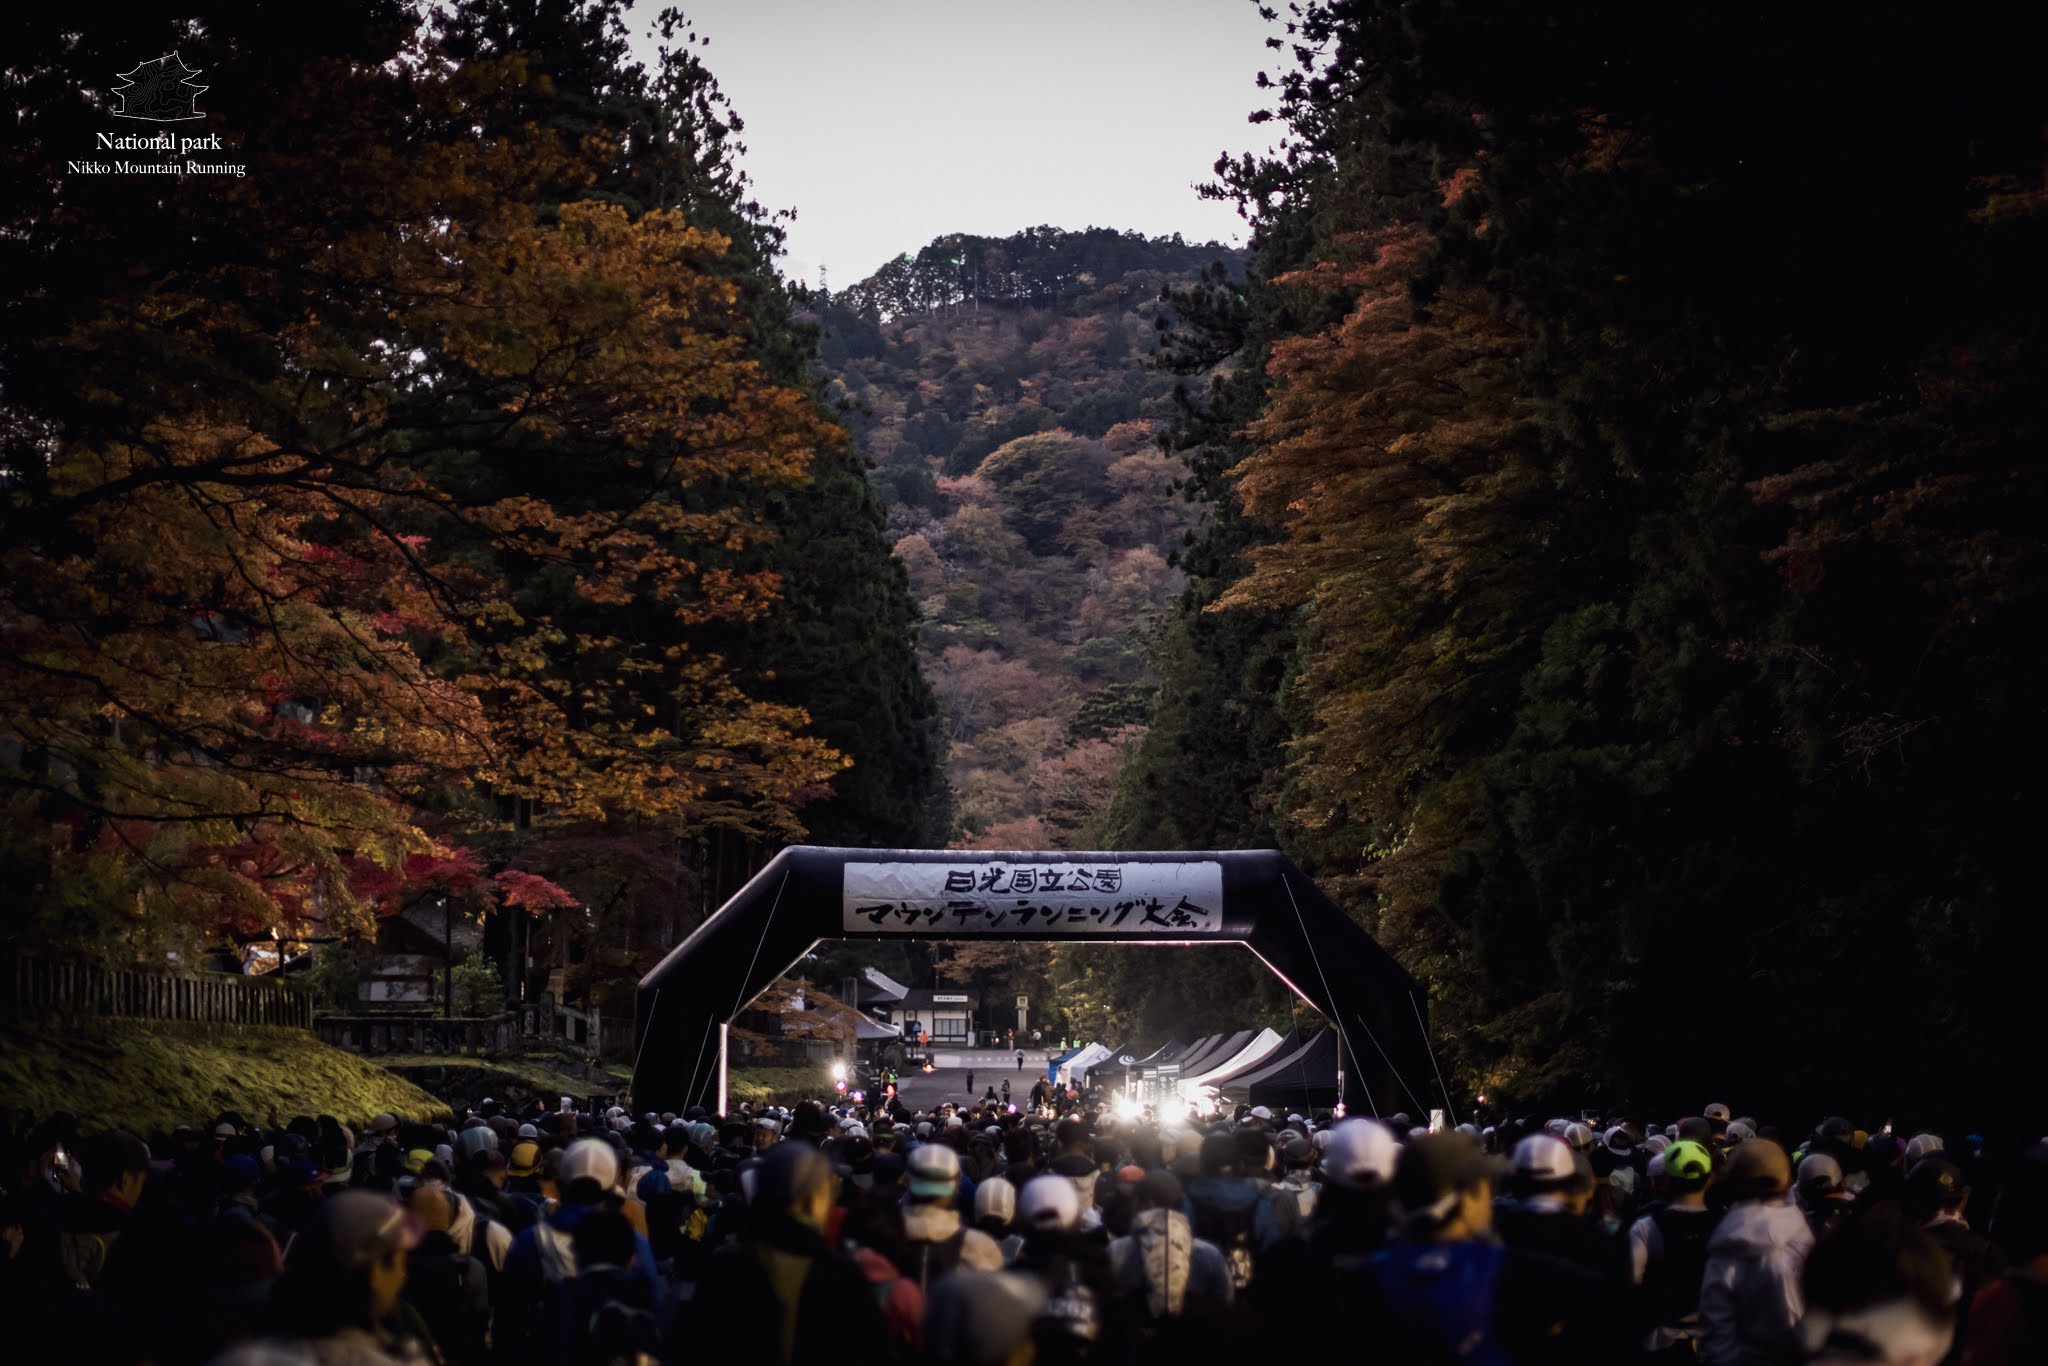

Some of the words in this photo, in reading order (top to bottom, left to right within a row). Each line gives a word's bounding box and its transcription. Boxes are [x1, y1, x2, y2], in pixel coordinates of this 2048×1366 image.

[944, 867, 1123, 894] 日光国立公園
[855, 896, 1208, 927] マウンテンランニング大会
